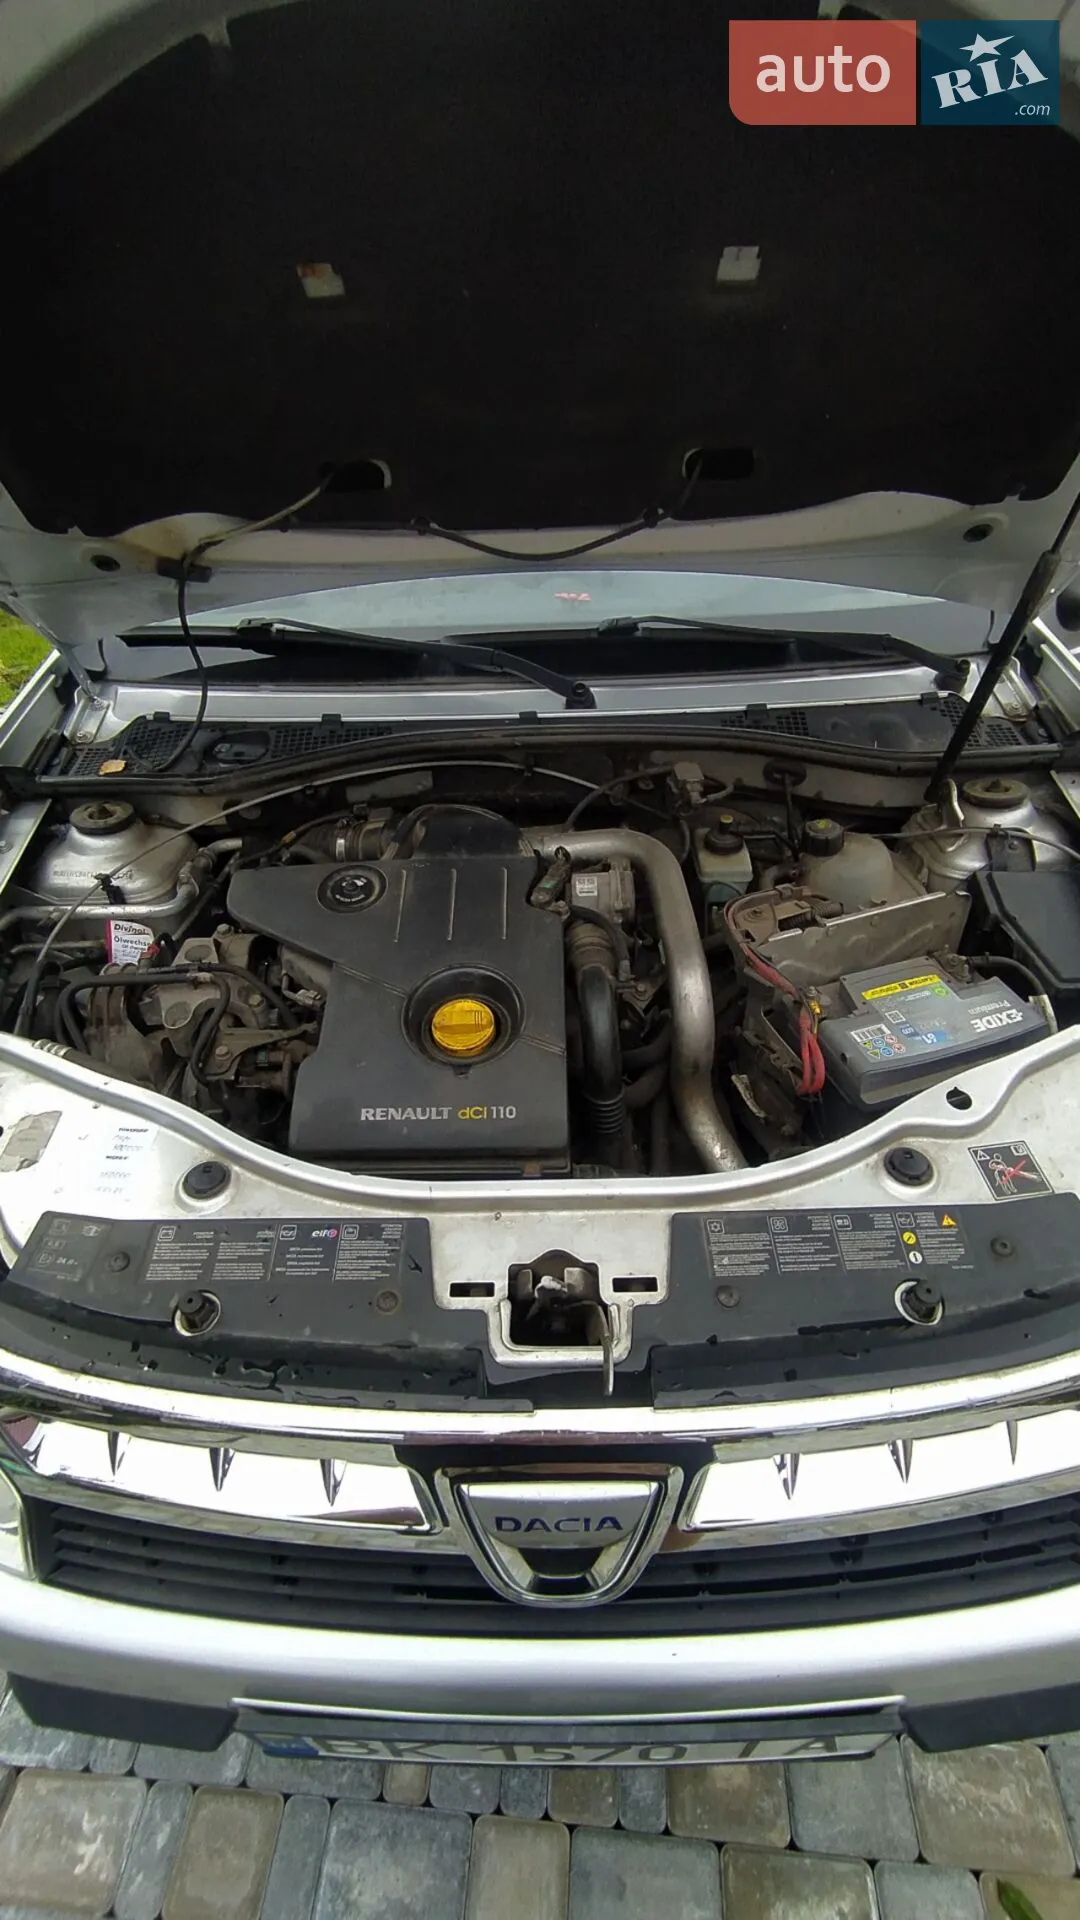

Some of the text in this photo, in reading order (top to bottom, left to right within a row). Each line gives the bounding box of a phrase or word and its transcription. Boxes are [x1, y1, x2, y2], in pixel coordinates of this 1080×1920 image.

[968, 1000, 1012, 1015] Premium
[970, 1008, 1024, 1033] EXIDE
[360, 1106, 452, 1121] RENAULT
[491, 1105, 516, 1119] 110
[494, 1515, 624, 1533] DACIA
